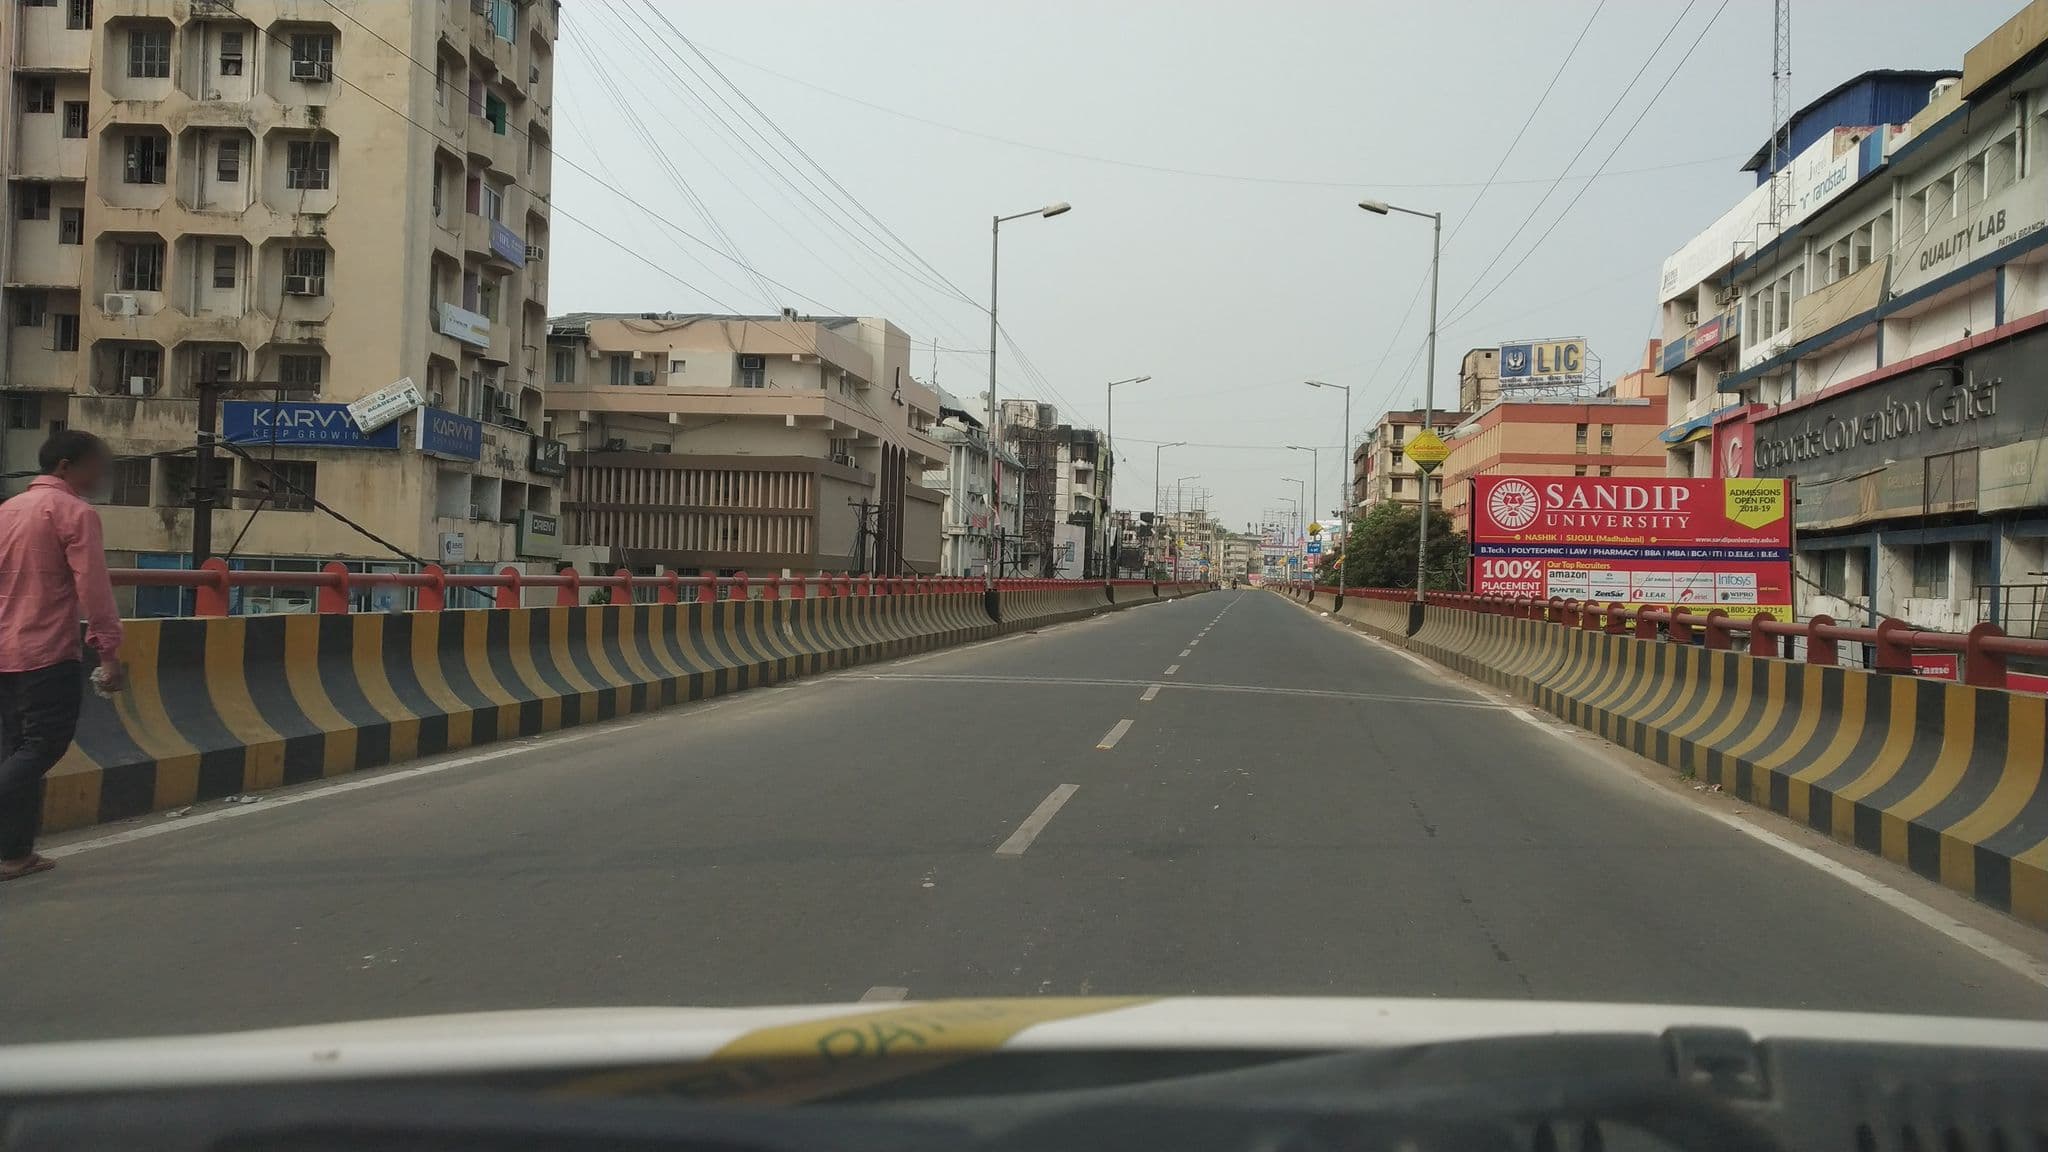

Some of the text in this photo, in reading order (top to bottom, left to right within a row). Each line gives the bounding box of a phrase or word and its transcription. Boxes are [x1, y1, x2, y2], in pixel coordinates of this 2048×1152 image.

[1813, 157, 1848, 203] randstad
[1920, 209, 2006, 272] QUALITY LAB
[1537, 343, 1579, 373] LIC
[252, 408, 352, 428] KARVY
[1754, 370, 2002, 474] Corporate Convention Center
[1546, 483, 1690, 510] SANDIP
[1729, 489, 1781, 497] ADMISSIONS
[1547, 514, 1690, 529] UNIVERSITY
[1596, 535, 1645, 544] (Madhubani)
[1511, 547, 1566, 555] POLYTECHNIC
[1593, 549, 1638, 557] PHARMACY
[1482, 559, 1541, 579] 100%
[1547, 561, 1611, 570] Our Top Recruiters
[1549, 570, 1587, 579] amazon
[1718, 573, 1752, 586] Infosys
[1481, 581, 1541, 590] PLACEMENT
